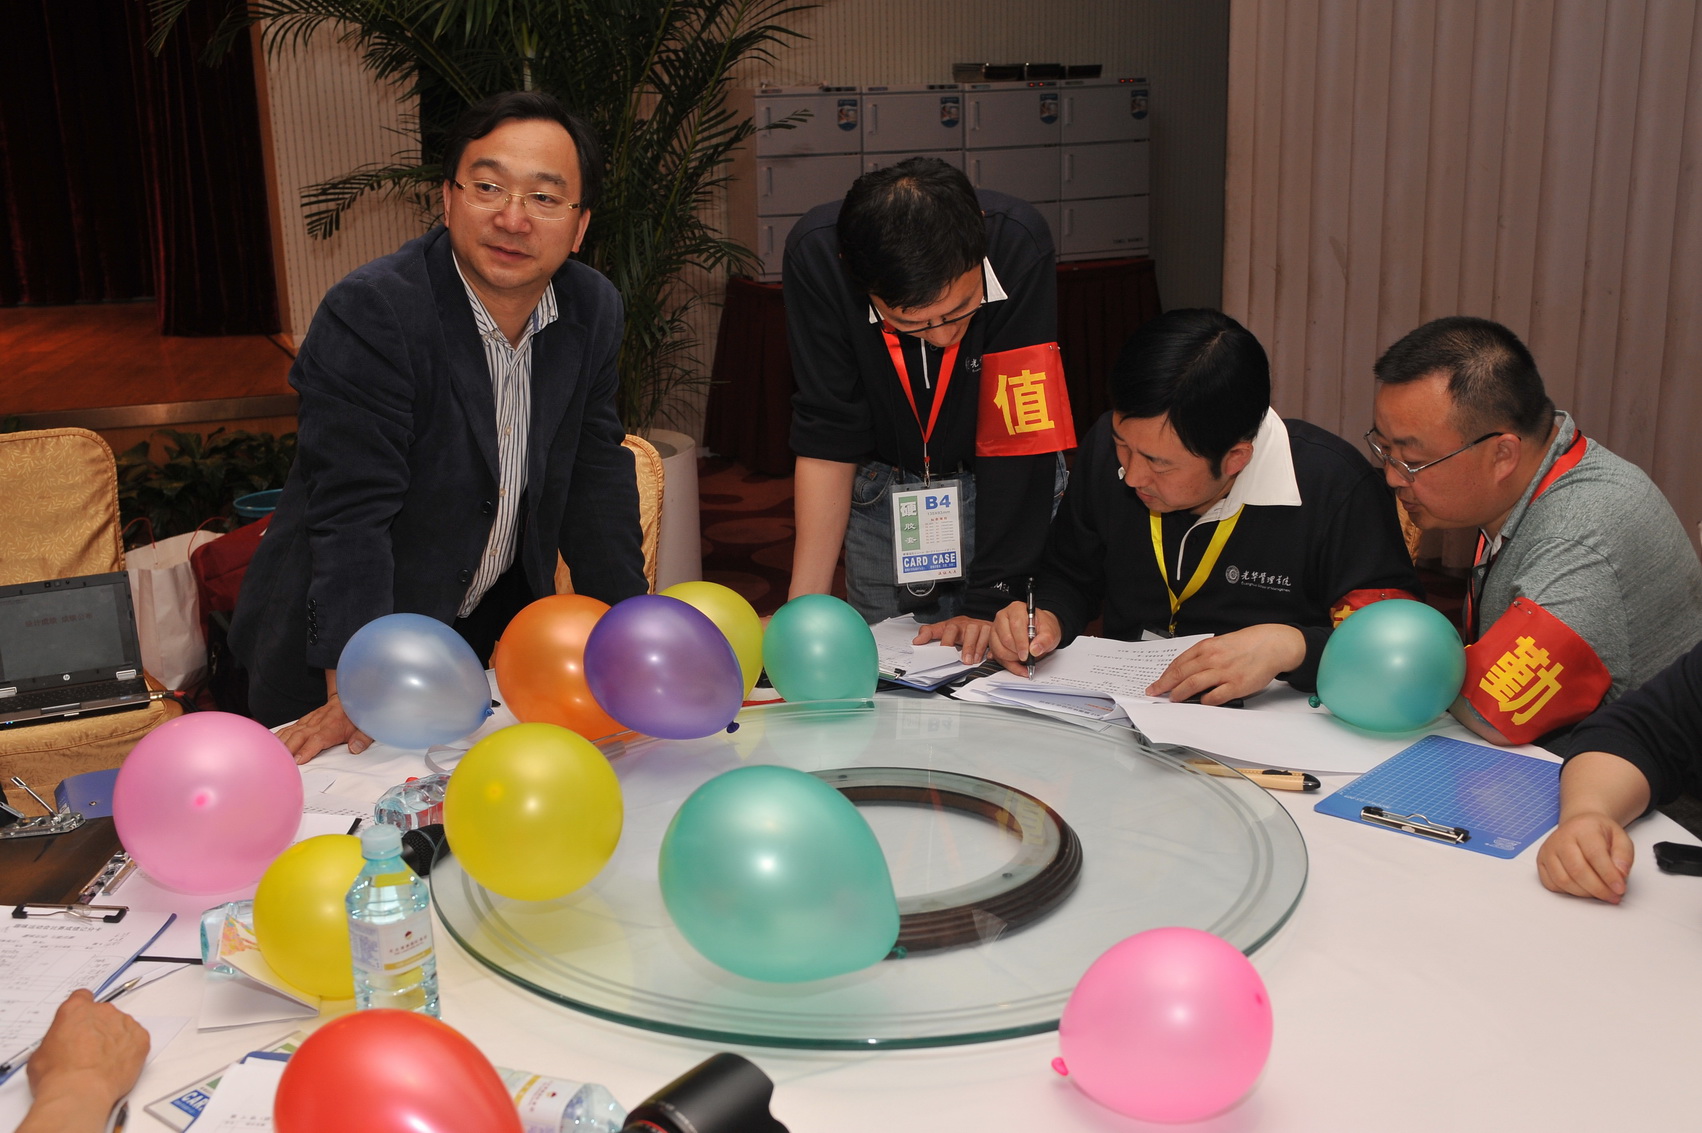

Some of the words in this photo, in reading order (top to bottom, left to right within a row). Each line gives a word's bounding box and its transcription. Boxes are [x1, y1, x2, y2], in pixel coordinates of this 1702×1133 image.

[993, 369, 1055, 436] 值
[925, 494, 951, 510] B4
[903, 555, 928, 568] CARD
[932, 552, 956, 564] CASE
[1479, 635, 1564, 726] 勤
[181, 1089, 209, 1111] CAR
